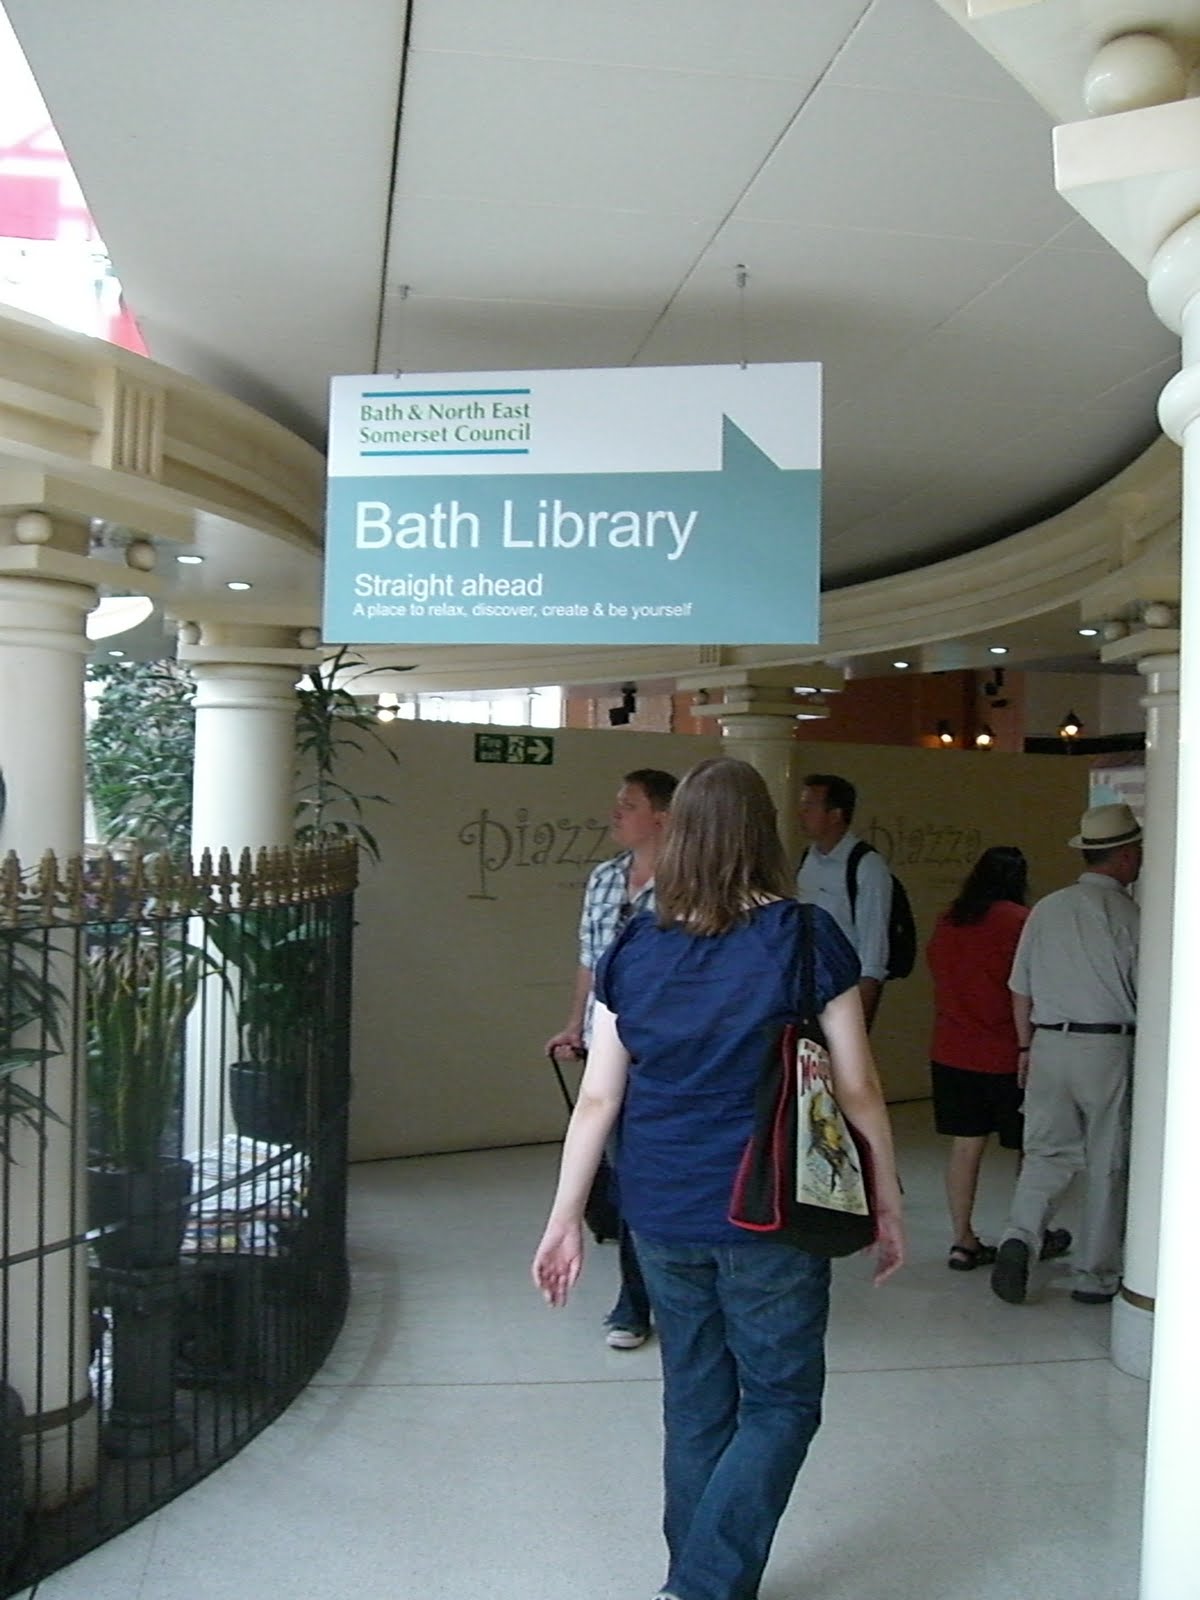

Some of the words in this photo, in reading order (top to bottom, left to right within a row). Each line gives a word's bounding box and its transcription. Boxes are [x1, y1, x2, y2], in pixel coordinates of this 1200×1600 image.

[361, 403, 403, 421] Bath
[408, 404, 422, 420] &
[429, 402, 485, 420] North
[492, 402, 531, 419] East
[360, 427, 448, 443] Somerset
[454, 423, 531, 441] Council
[356, 500, 479, 549] Bath
[503, 499, 698, 560] Library
[354, 573, 454, 602] Straight
[461, 573, 543, 596] ahead
[353, 603, 365, 616] A
[367, 603, 406, 619] place
[410, 603, 425, 616] to
[428, 603, 467, 617] relax,
[472, 603, 537, 617] discover,
[542, 603, 589, 616] create
[593, 603, 603, 616] &
[608, 603, 628, 616] be
[632, 603, 693, 619] yourself
[458, 807, 610, 899] Piazz
